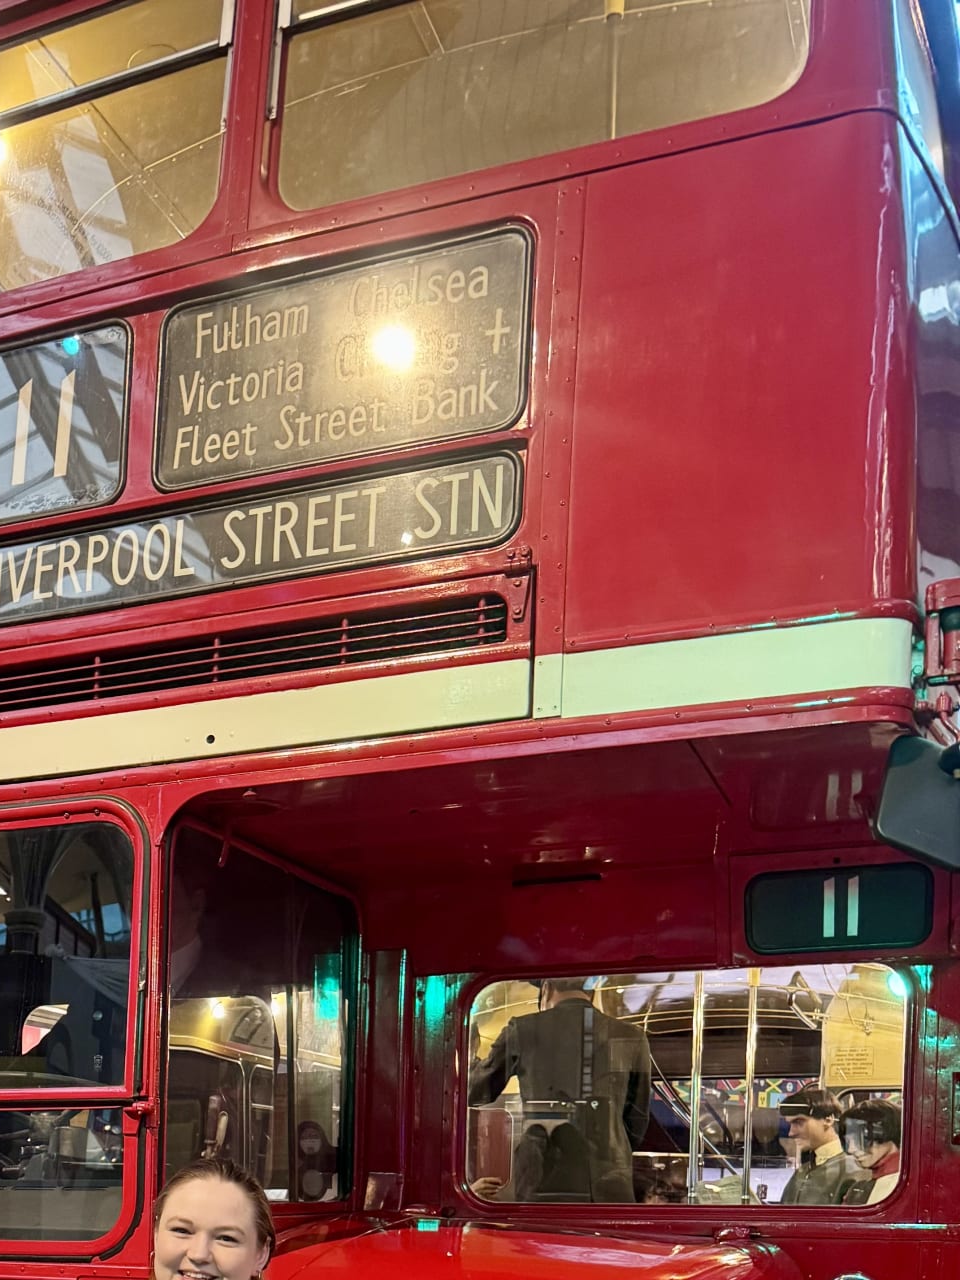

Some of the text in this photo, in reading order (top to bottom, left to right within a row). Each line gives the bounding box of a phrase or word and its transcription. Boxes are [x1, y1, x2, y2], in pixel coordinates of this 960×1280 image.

[196, 265, 489, 359] Fulham Chelsea
[11, 368, 76, 486] 11
[173, 368, 499, 470] Fleet Street Bank
[179, 360, 304, 416] Victoria
[220, 486, 387, 570] STREET
[414, 465, 504, 540] STN
[823, 875, 860, 938] 11
